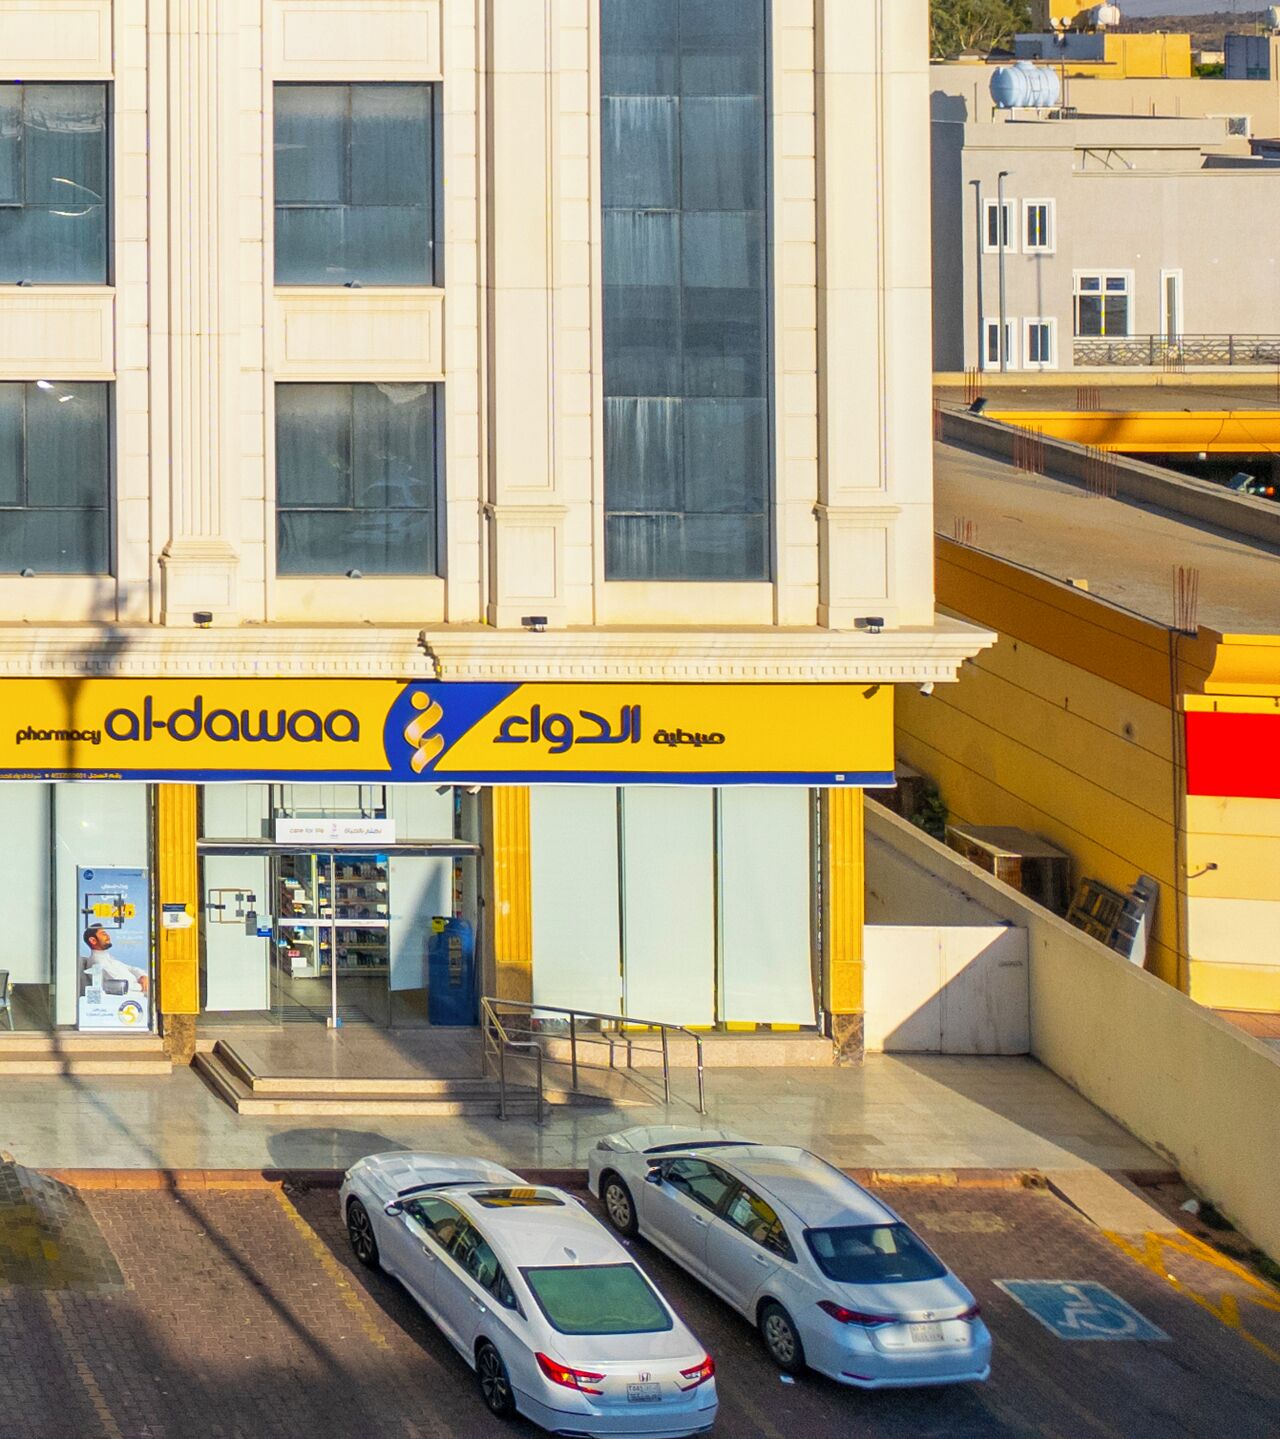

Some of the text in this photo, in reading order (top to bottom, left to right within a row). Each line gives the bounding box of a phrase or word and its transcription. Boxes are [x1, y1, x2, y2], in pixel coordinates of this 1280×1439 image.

[15, 694, 360, 745] pharmacy al-dawaa
[492, 703, 641, 754] الدواء
